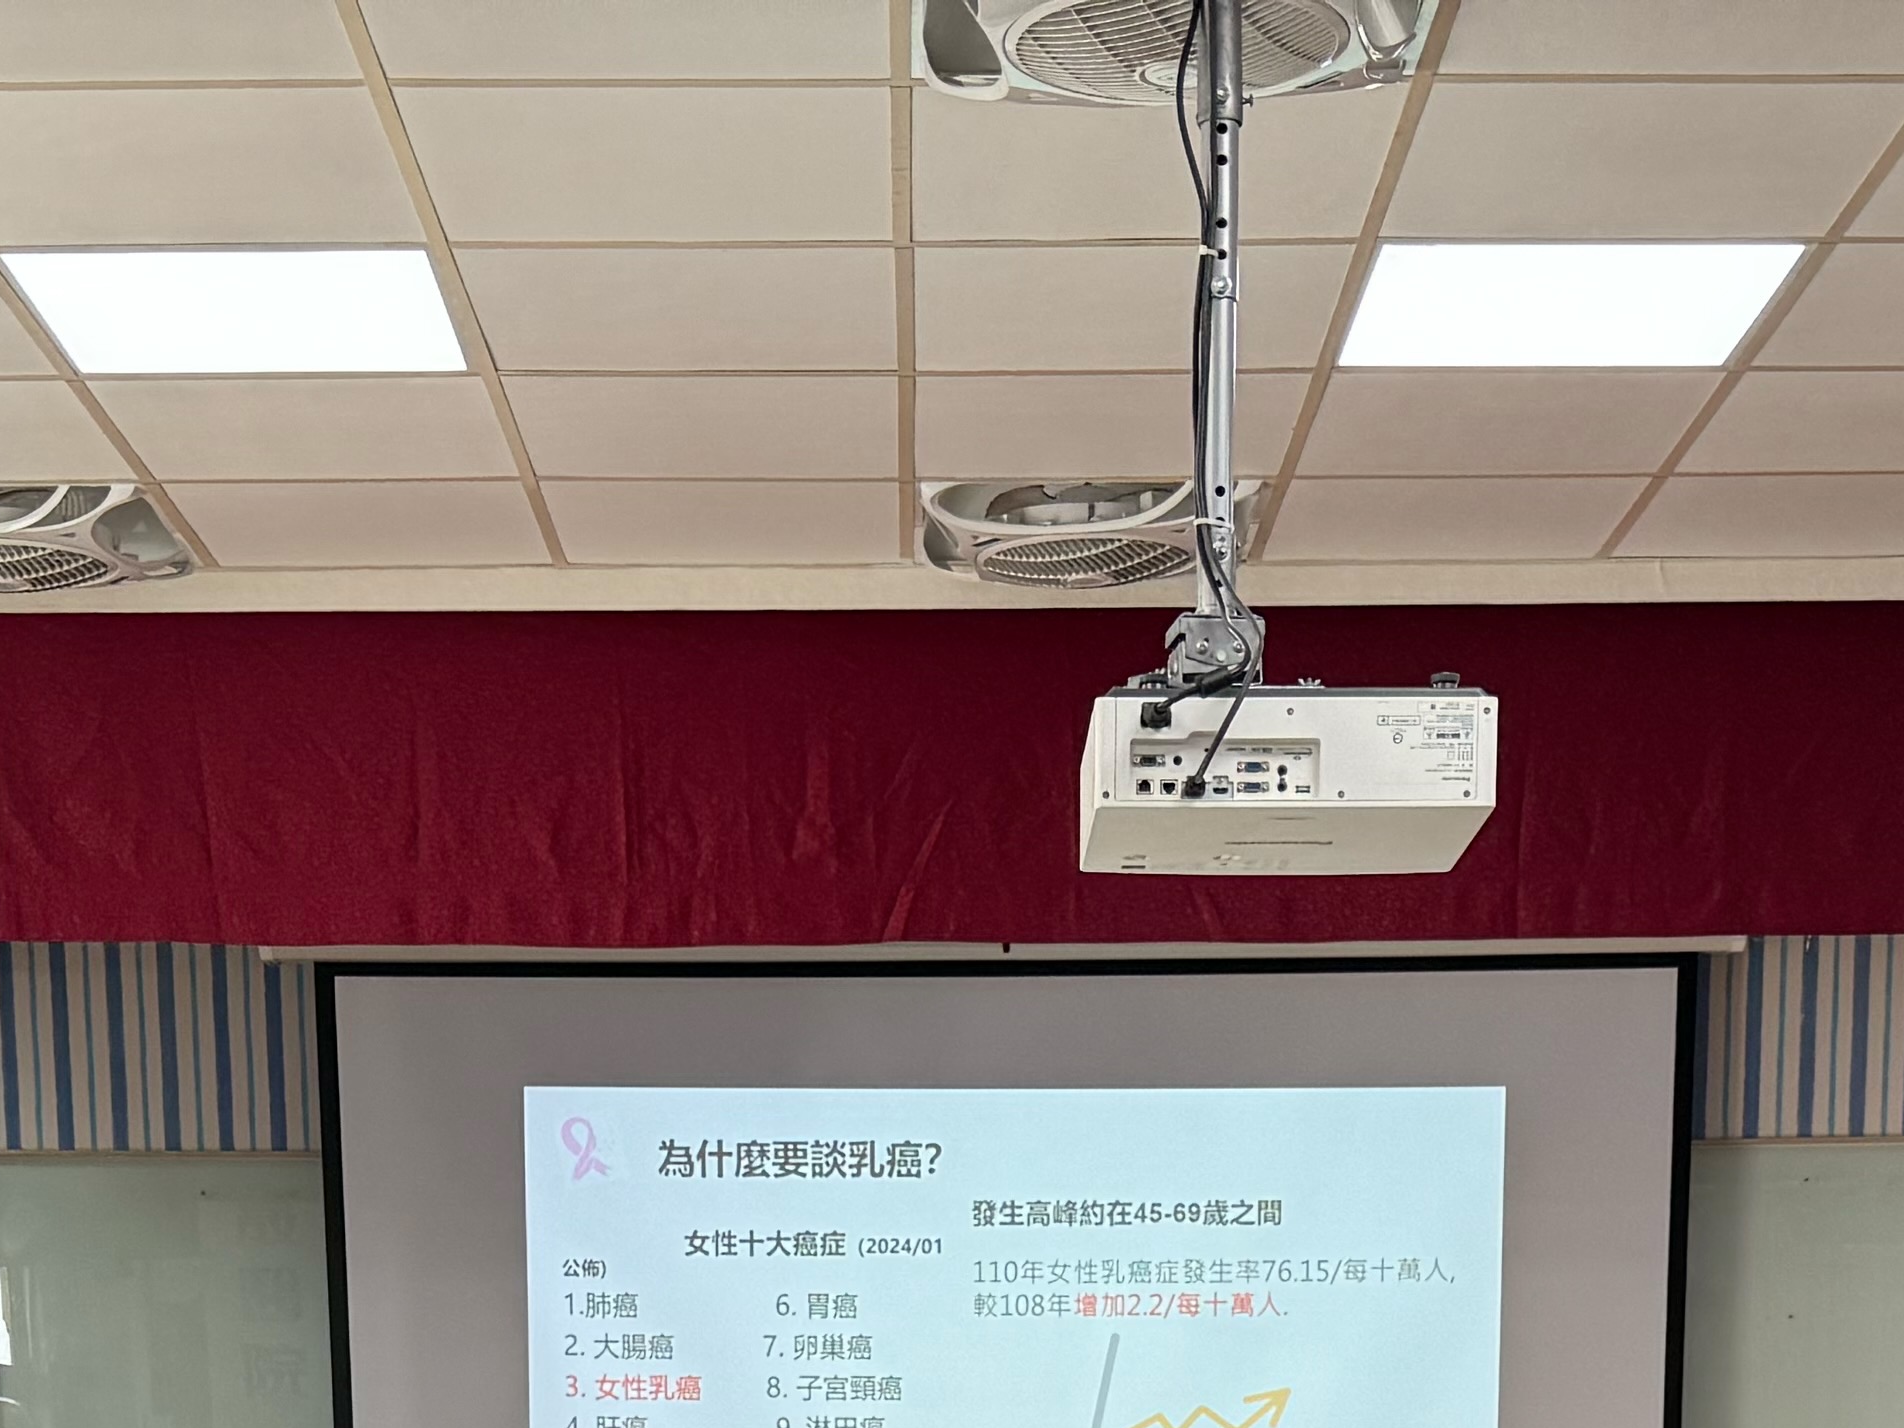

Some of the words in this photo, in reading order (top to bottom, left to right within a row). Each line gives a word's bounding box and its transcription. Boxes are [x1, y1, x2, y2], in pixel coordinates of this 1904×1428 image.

[658, 1139, 944, 1179] 為什麼要談乳癌?
[972, 1199, 1283, 1228] 發生高峰約在45-69歲之間
[684, 1230, 847, 1258] 女性十大癌症
[857, 1237, 943, 1258] (2024/01
[562, 1258, 607, 1279] 公佈)
[973, 1258, 1455, 1286] 110年女性乳癌症發生率76.15/每十萬人,
[564, 1291, 639, 1320] 1.肺癌
[776, 1294, 797, 1317] 6.
[807, 1292, 858, 1320] 胃癌
[973, 1291, 1289, 1319] 較108年增加2.2/每十萬人.
[564, 1334, 586, 1357] 2.
[593, 1333, 675, 1361] 大腸癌
[763, 1335, 785, 1359] 7.
[794, 1333, 873, 1361] 卵巢癌
[565, 1375, 586, 1399] 3.
[596, 1374, 702, 1402] 女性乳癌
[767, 1376, 788, 1400] 8.
[797, 1375, 903, 1402] 子宮頸癌
